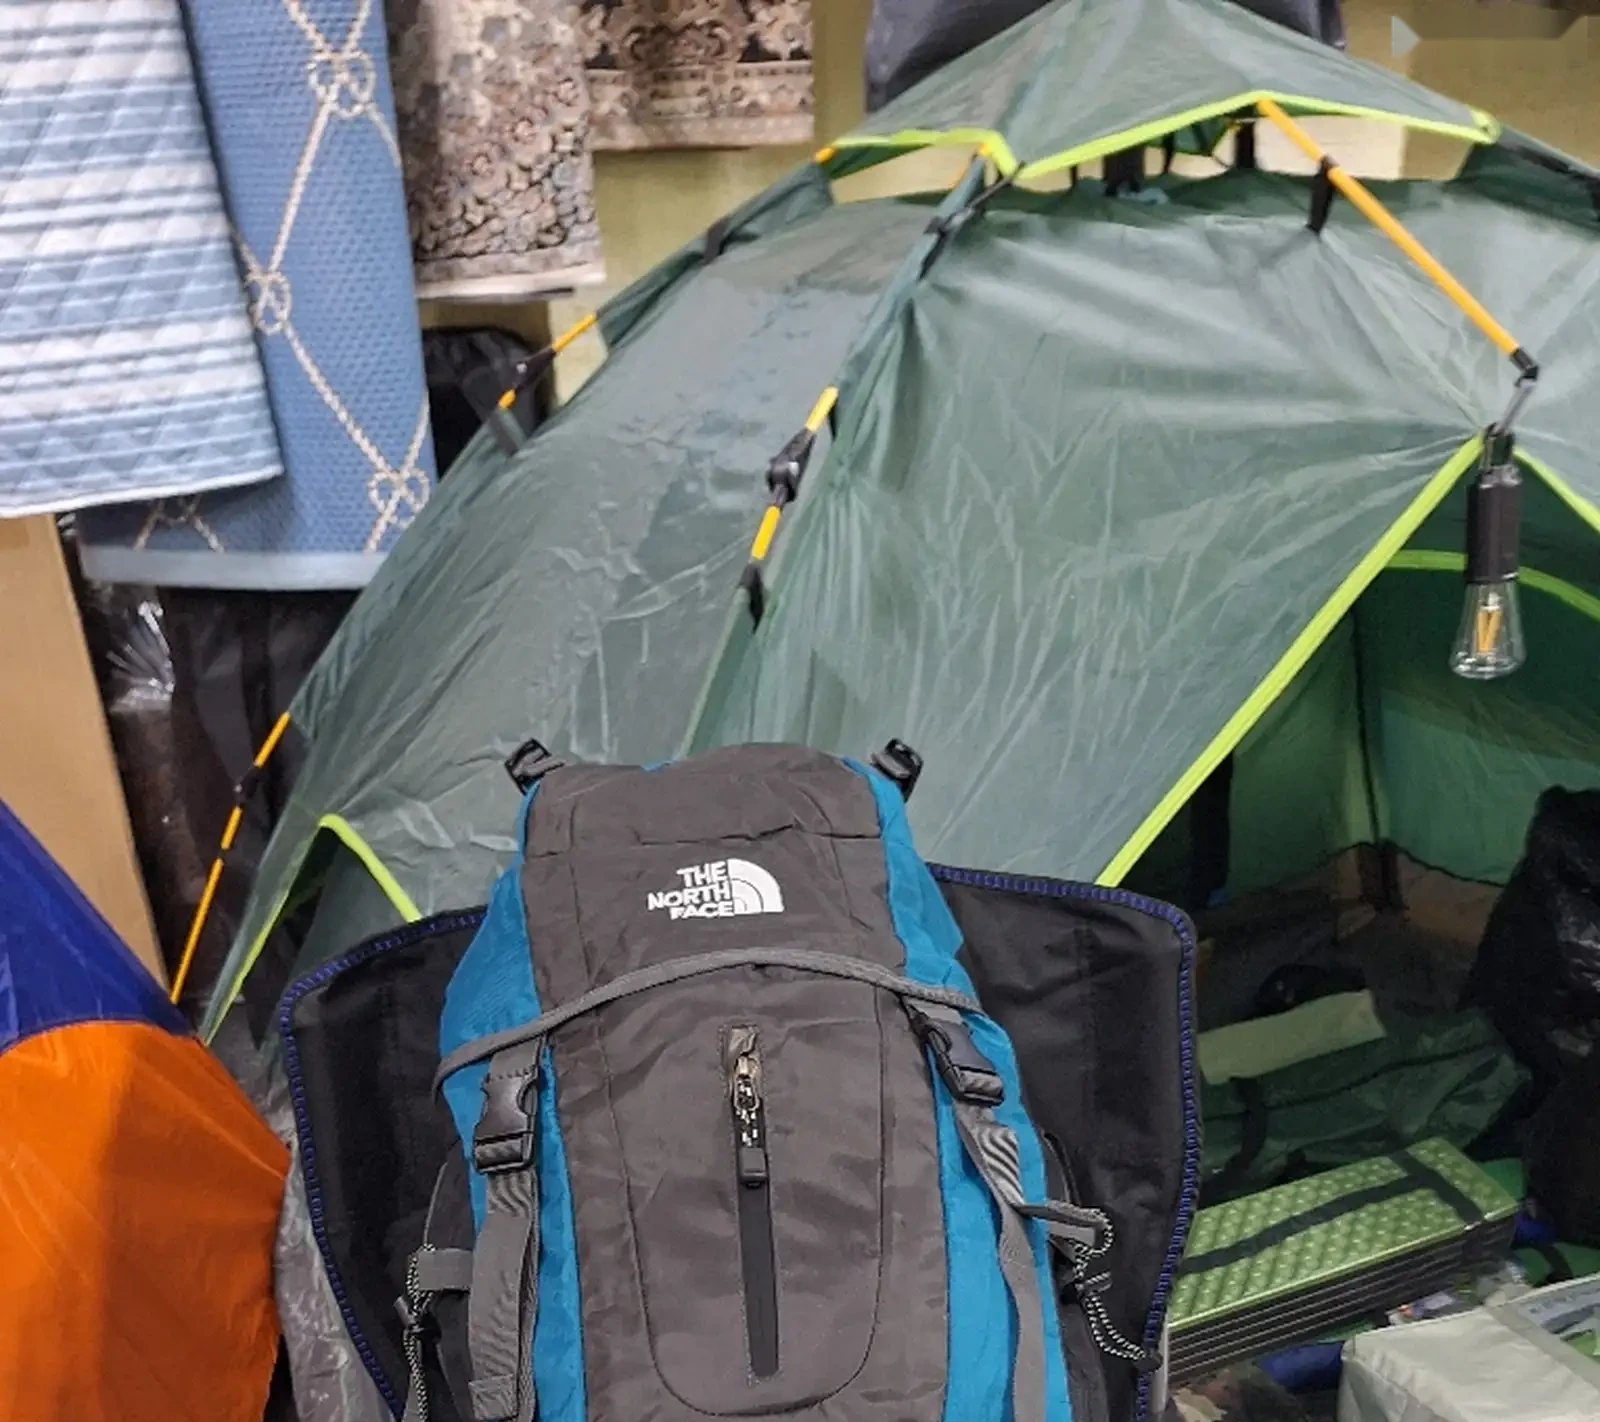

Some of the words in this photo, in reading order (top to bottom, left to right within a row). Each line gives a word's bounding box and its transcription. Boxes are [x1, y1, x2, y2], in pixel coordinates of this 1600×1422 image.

[676, 861, 727, 887] THE
[647, 879, 731, 910] NORTH
[669, 901, 734, 920] FACE
